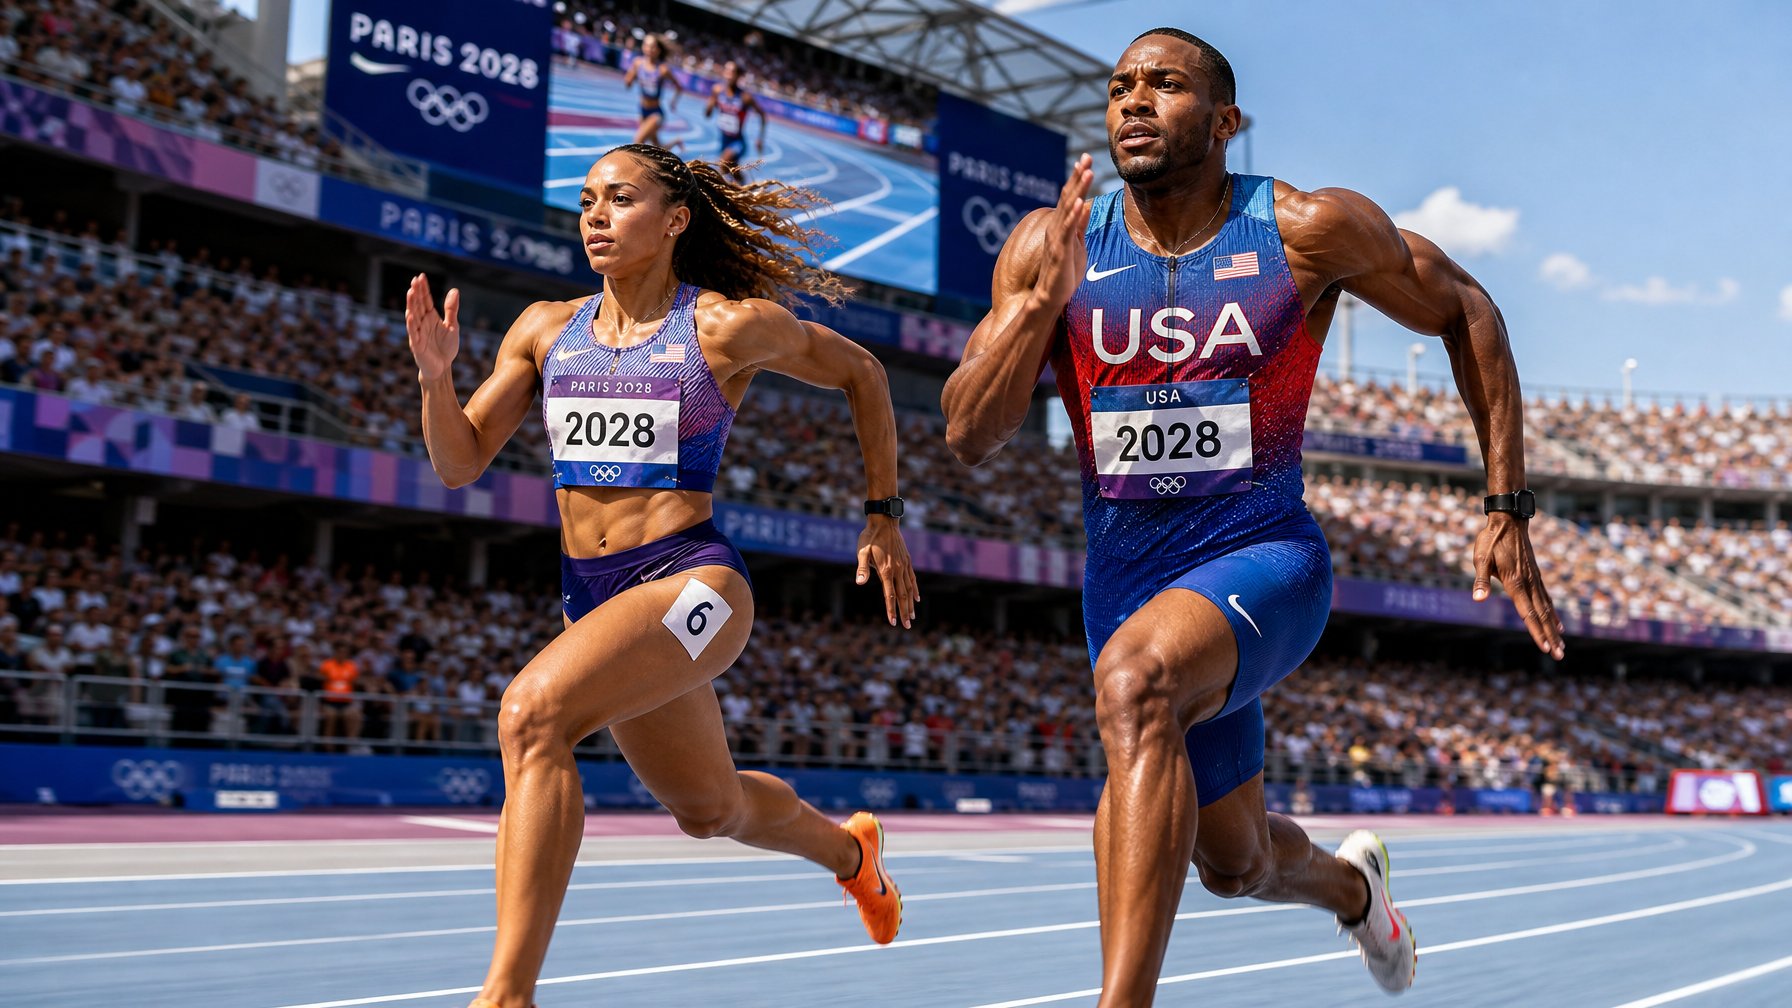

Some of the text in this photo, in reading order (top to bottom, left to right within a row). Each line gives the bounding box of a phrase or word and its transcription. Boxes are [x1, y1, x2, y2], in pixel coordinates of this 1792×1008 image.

[350, 12, 539, 89] PARIS 2028
[949, 151, 1011, 191] PARIS
[380, 201, 481, 252] PARIS
[1092, 302, 1262, 364] USA
[570, 381, 652, 394] PARIS 2028
[1146, 389, 1181, 404] USA
[565, 411, 655, 448] 2028
[1116, 420, 1221, 462] 2028
[724, 500, 801, 547] PARIS
[686, 601, 714, 636] 6
[209, 763, 274, 786] PARIS
